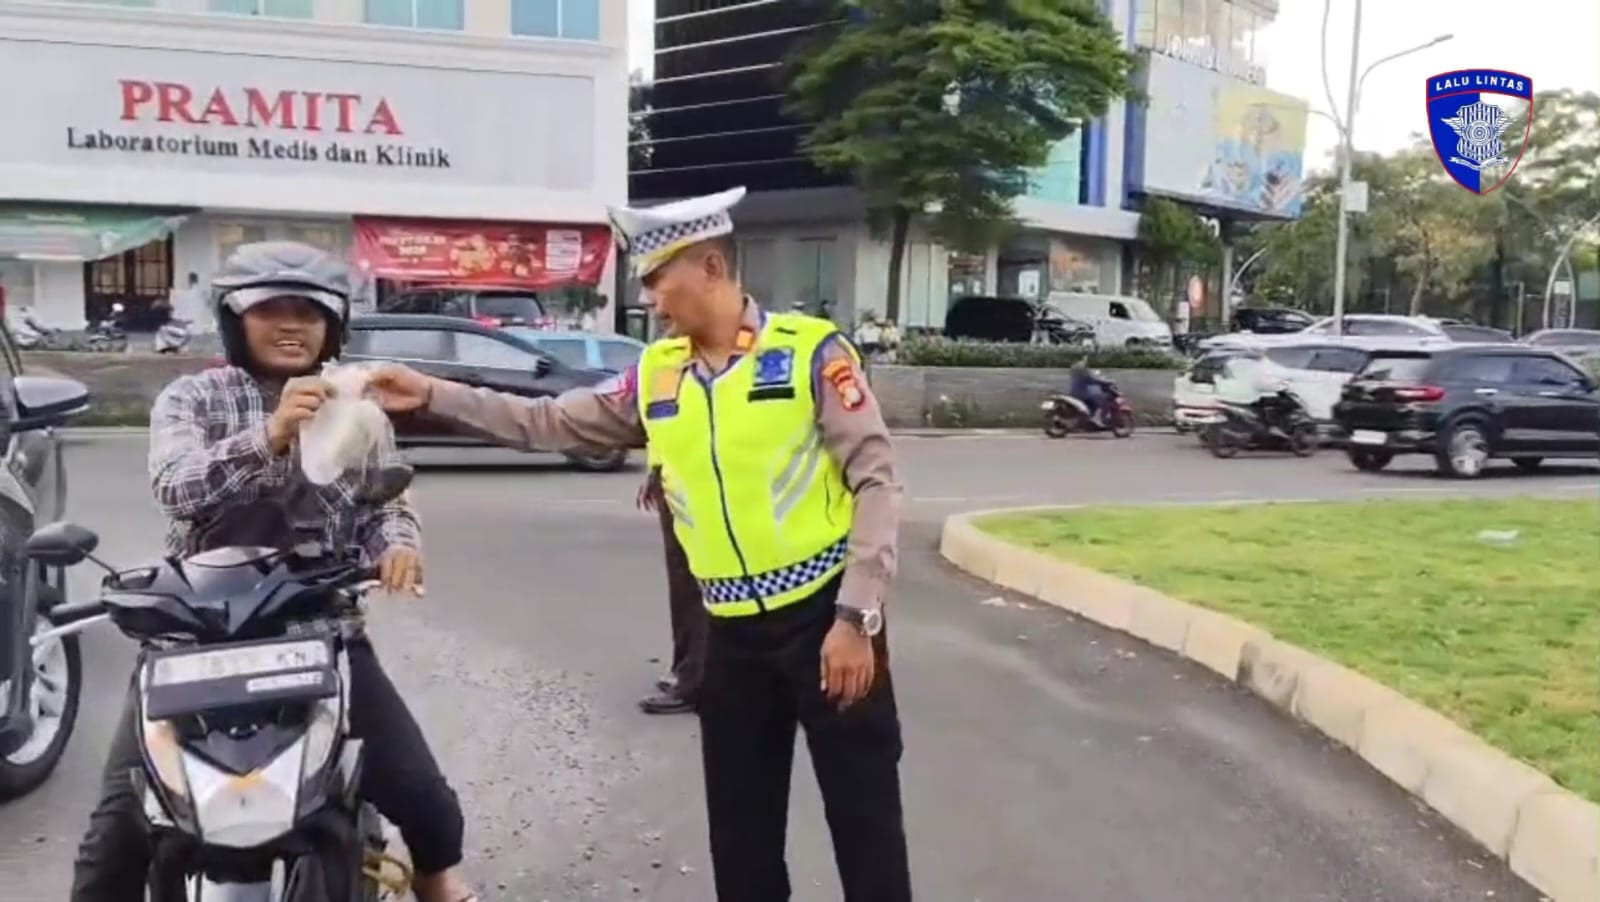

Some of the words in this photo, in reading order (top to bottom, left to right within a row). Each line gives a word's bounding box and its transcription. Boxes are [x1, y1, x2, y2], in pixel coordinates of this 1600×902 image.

[118, 79, 403, 135] PRAMITA
[67, 127, 239, 156] Laboratorium
[247, 138, 318, 162] Medis
[325, 142, 367, 164] dan
[376, 145, 451, 168] Klinik
